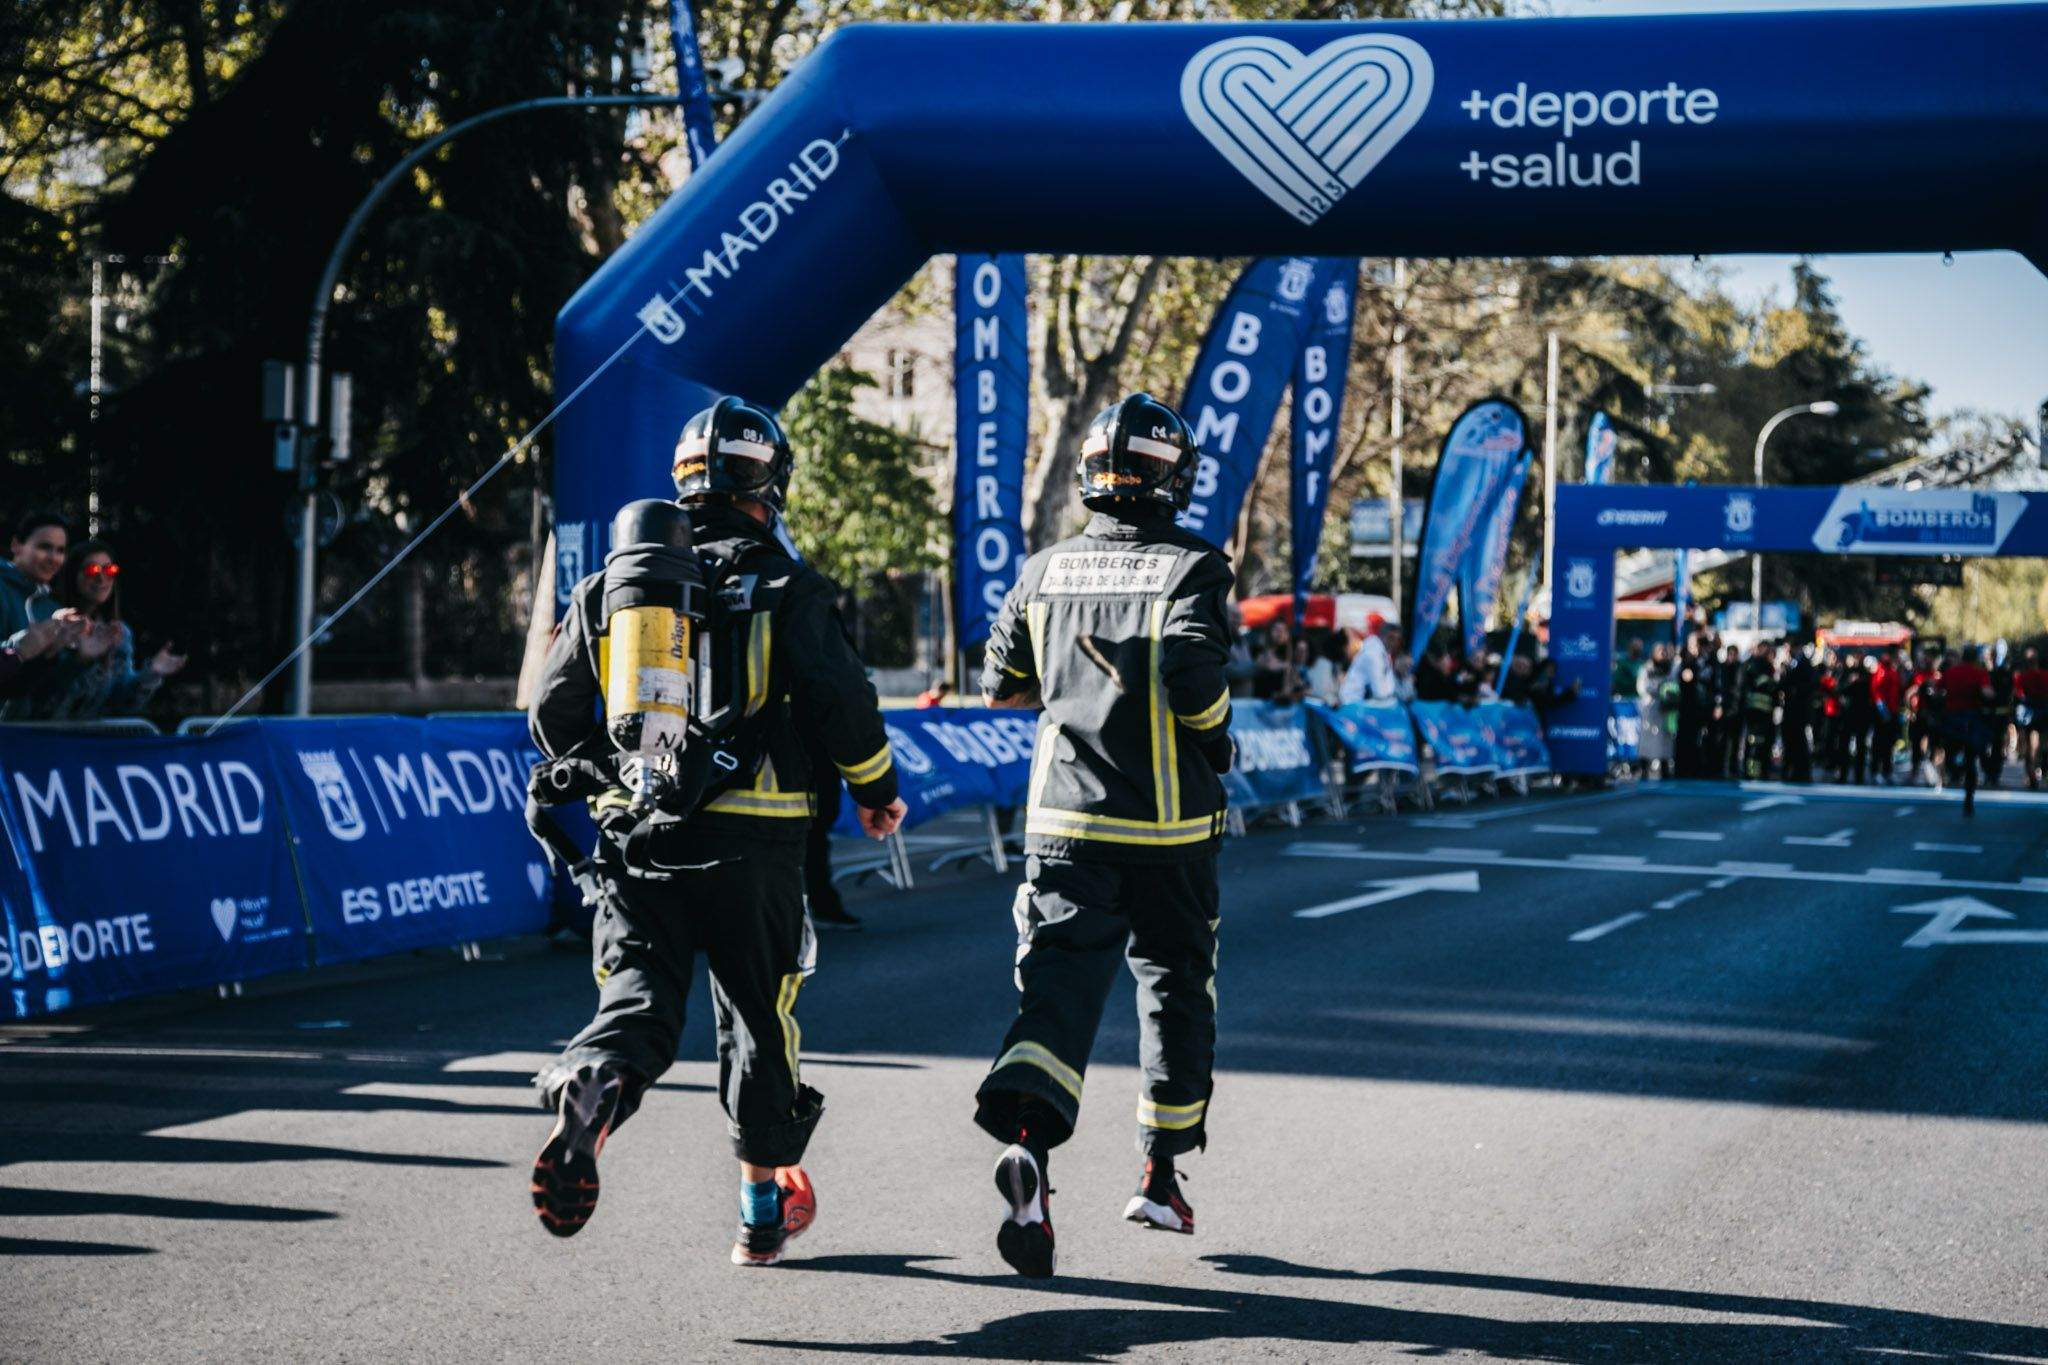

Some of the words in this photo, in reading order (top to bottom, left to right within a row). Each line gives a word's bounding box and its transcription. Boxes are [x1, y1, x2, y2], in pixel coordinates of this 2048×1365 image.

[1461, 82, 1718, 137] +deporte
[1460, 141, 1641, 188] +salud
[685, 138, 840, 297] MADRID
[973, 261, 1010, 622] OMBEROS
[1876, 510, 1992, 528] BOMBEROS
[1059, 556, 1160, 571] BOMBEROS
[671, 614, 687, 660] Dräge
[14, 760, 265, 853] MADRID
[373, 748, 541, 819] MADRI
[342, 887, 381, 924] ES
[19, 913, 155, 971] DEPORTE
